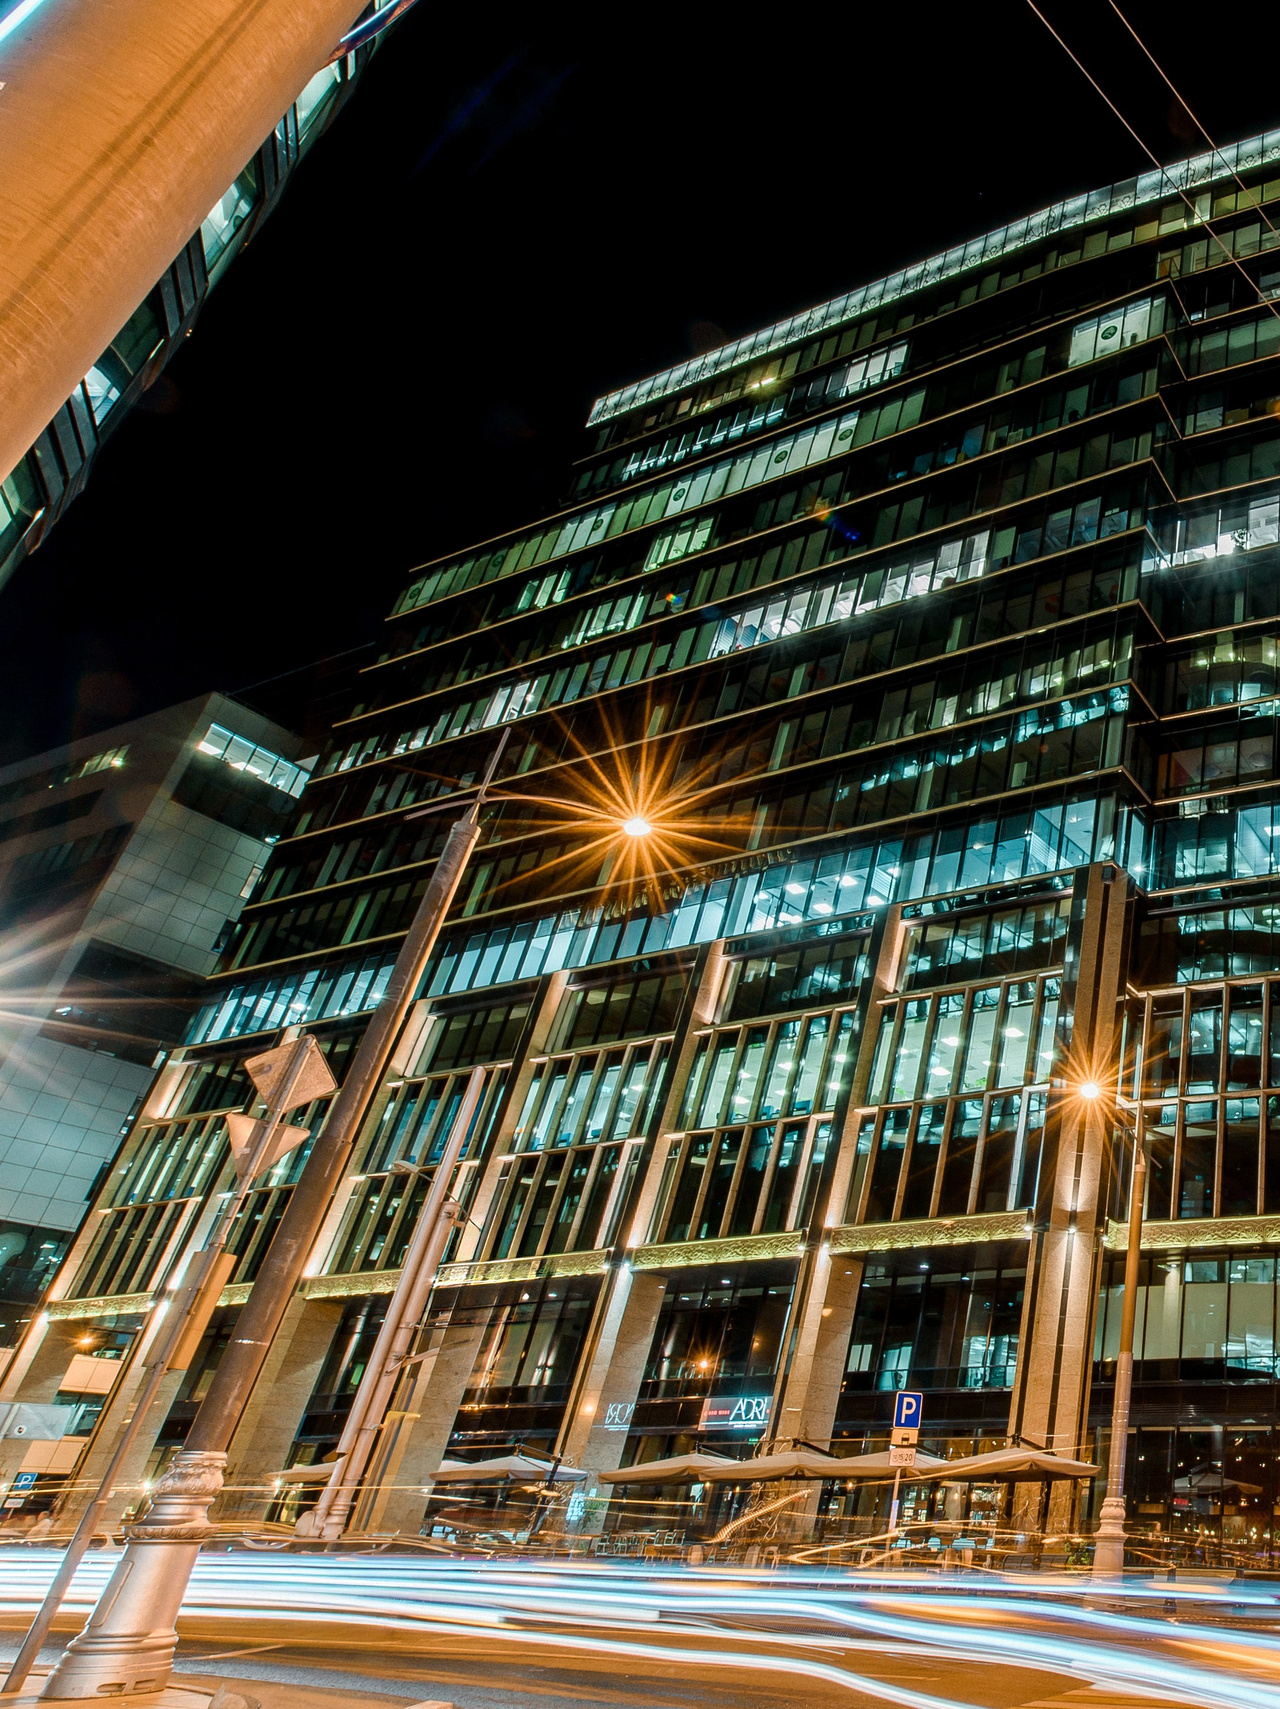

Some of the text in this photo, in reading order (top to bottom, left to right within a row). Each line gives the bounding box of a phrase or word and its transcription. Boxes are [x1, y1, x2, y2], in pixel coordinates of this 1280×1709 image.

[729, 1397, 768, 1421] ADRI
[901, 1397, 917, 1424] P
[904, 1453, 913, 1461] 20
